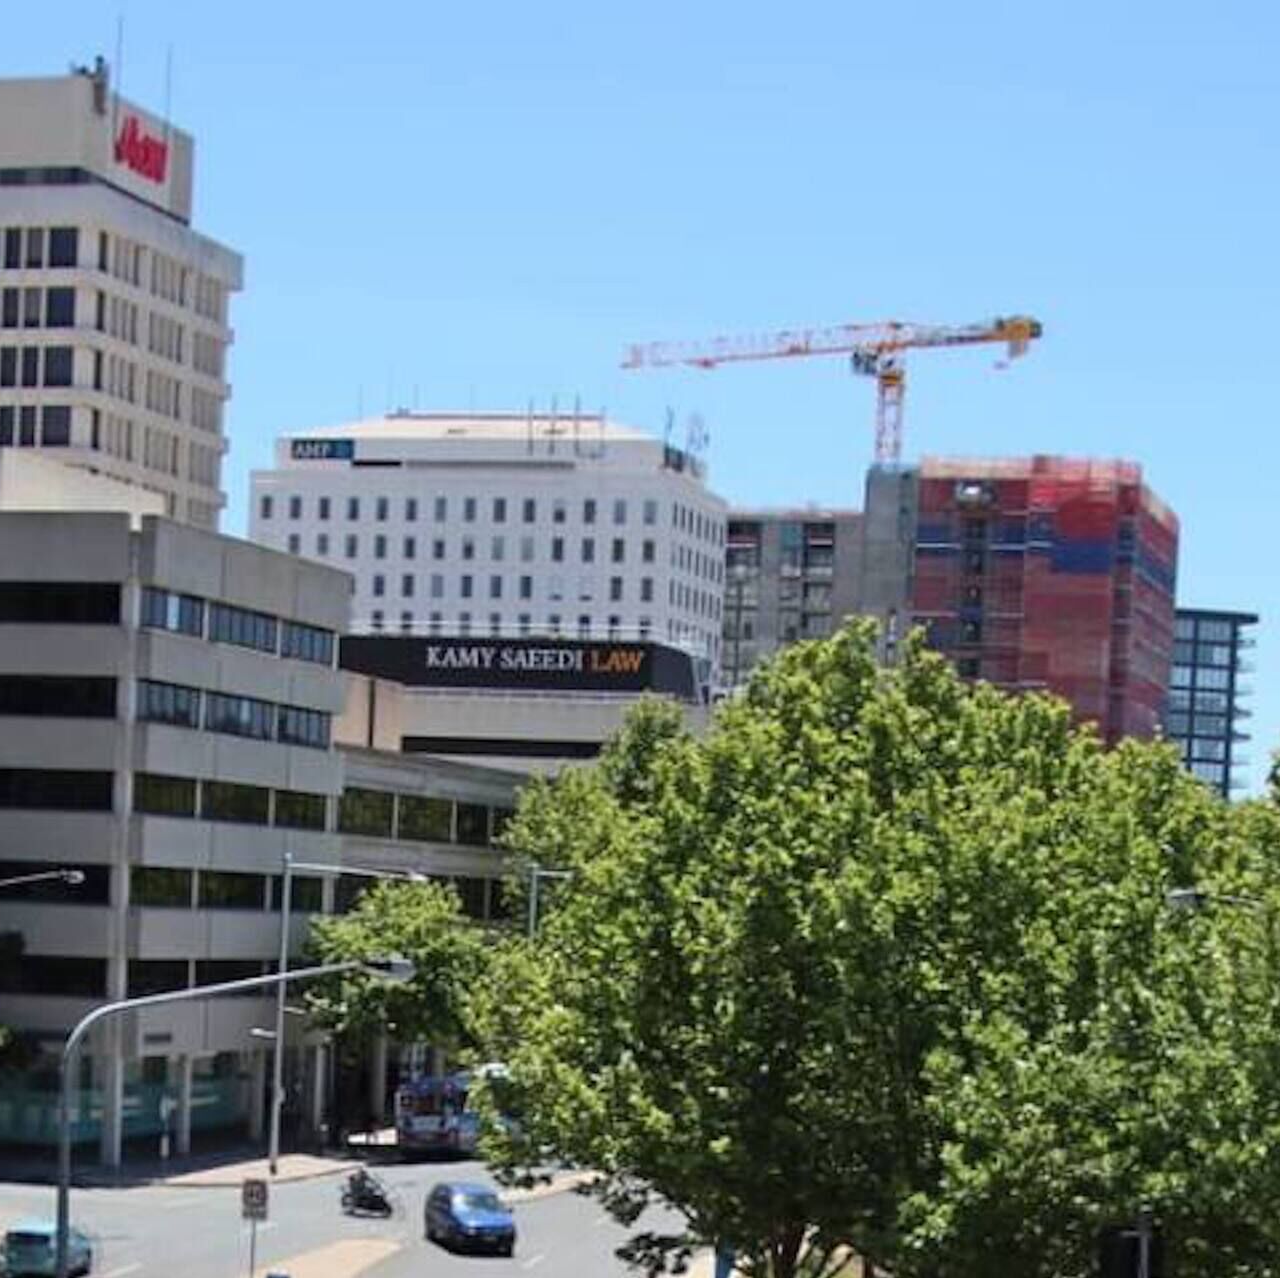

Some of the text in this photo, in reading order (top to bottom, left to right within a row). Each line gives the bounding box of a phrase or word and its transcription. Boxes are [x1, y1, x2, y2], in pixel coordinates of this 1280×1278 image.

[426, 647, 642, 673] KAMY SAEEDI LAW
